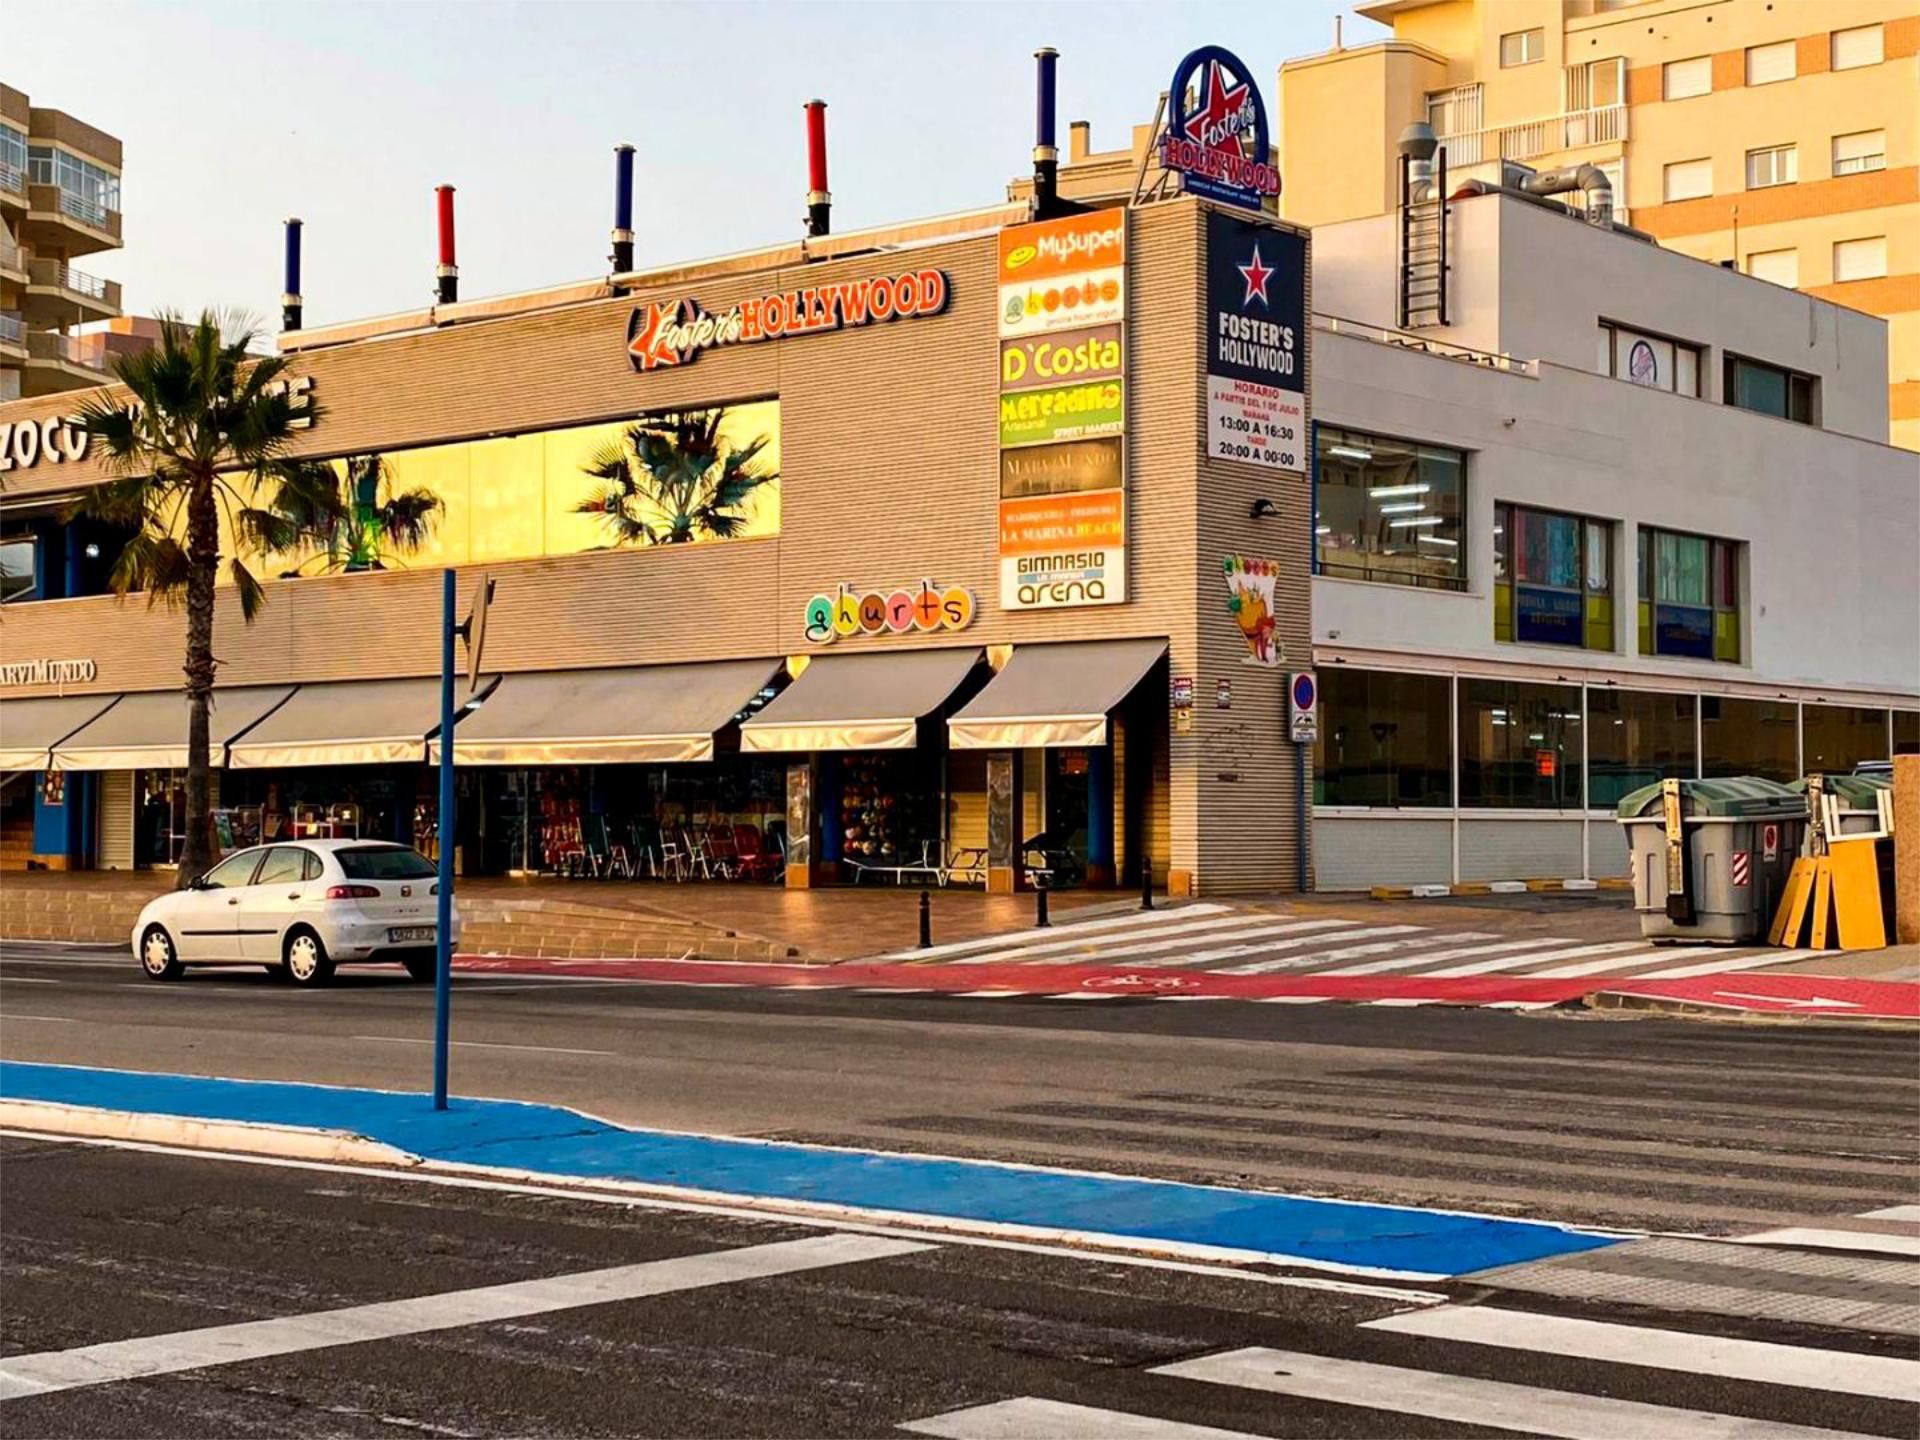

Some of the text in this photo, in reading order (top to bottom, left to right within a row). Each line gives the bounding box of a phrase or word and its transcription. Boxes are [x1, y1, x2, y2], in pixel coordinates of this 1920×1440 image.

[1166, 136, 1282, 196] HOLLYWOOD
[1038, 227, 1123, 262] MySuper
[649, 268, 947, 357] Foster's HOLLYWOOD
[1219, 312, 1293, 350] FOSTER'S
[1219, 337, 1293, 375] HOLLYWOOD
[1234, 381, 1279, 399] HORARIO
[1247, 398, 1260, 408] DEL
[1268, 403, 1278, 412] DE
[1279, 404, 1299, 415] JULIO
[1220, 416, 1293, 440] 13:00 A 16:30
[1219, 441, 1294, 465] 20:00 A 00:00
[1018, 580, 1105, 604] arena
[804, 580, 967, 642] ghurts
